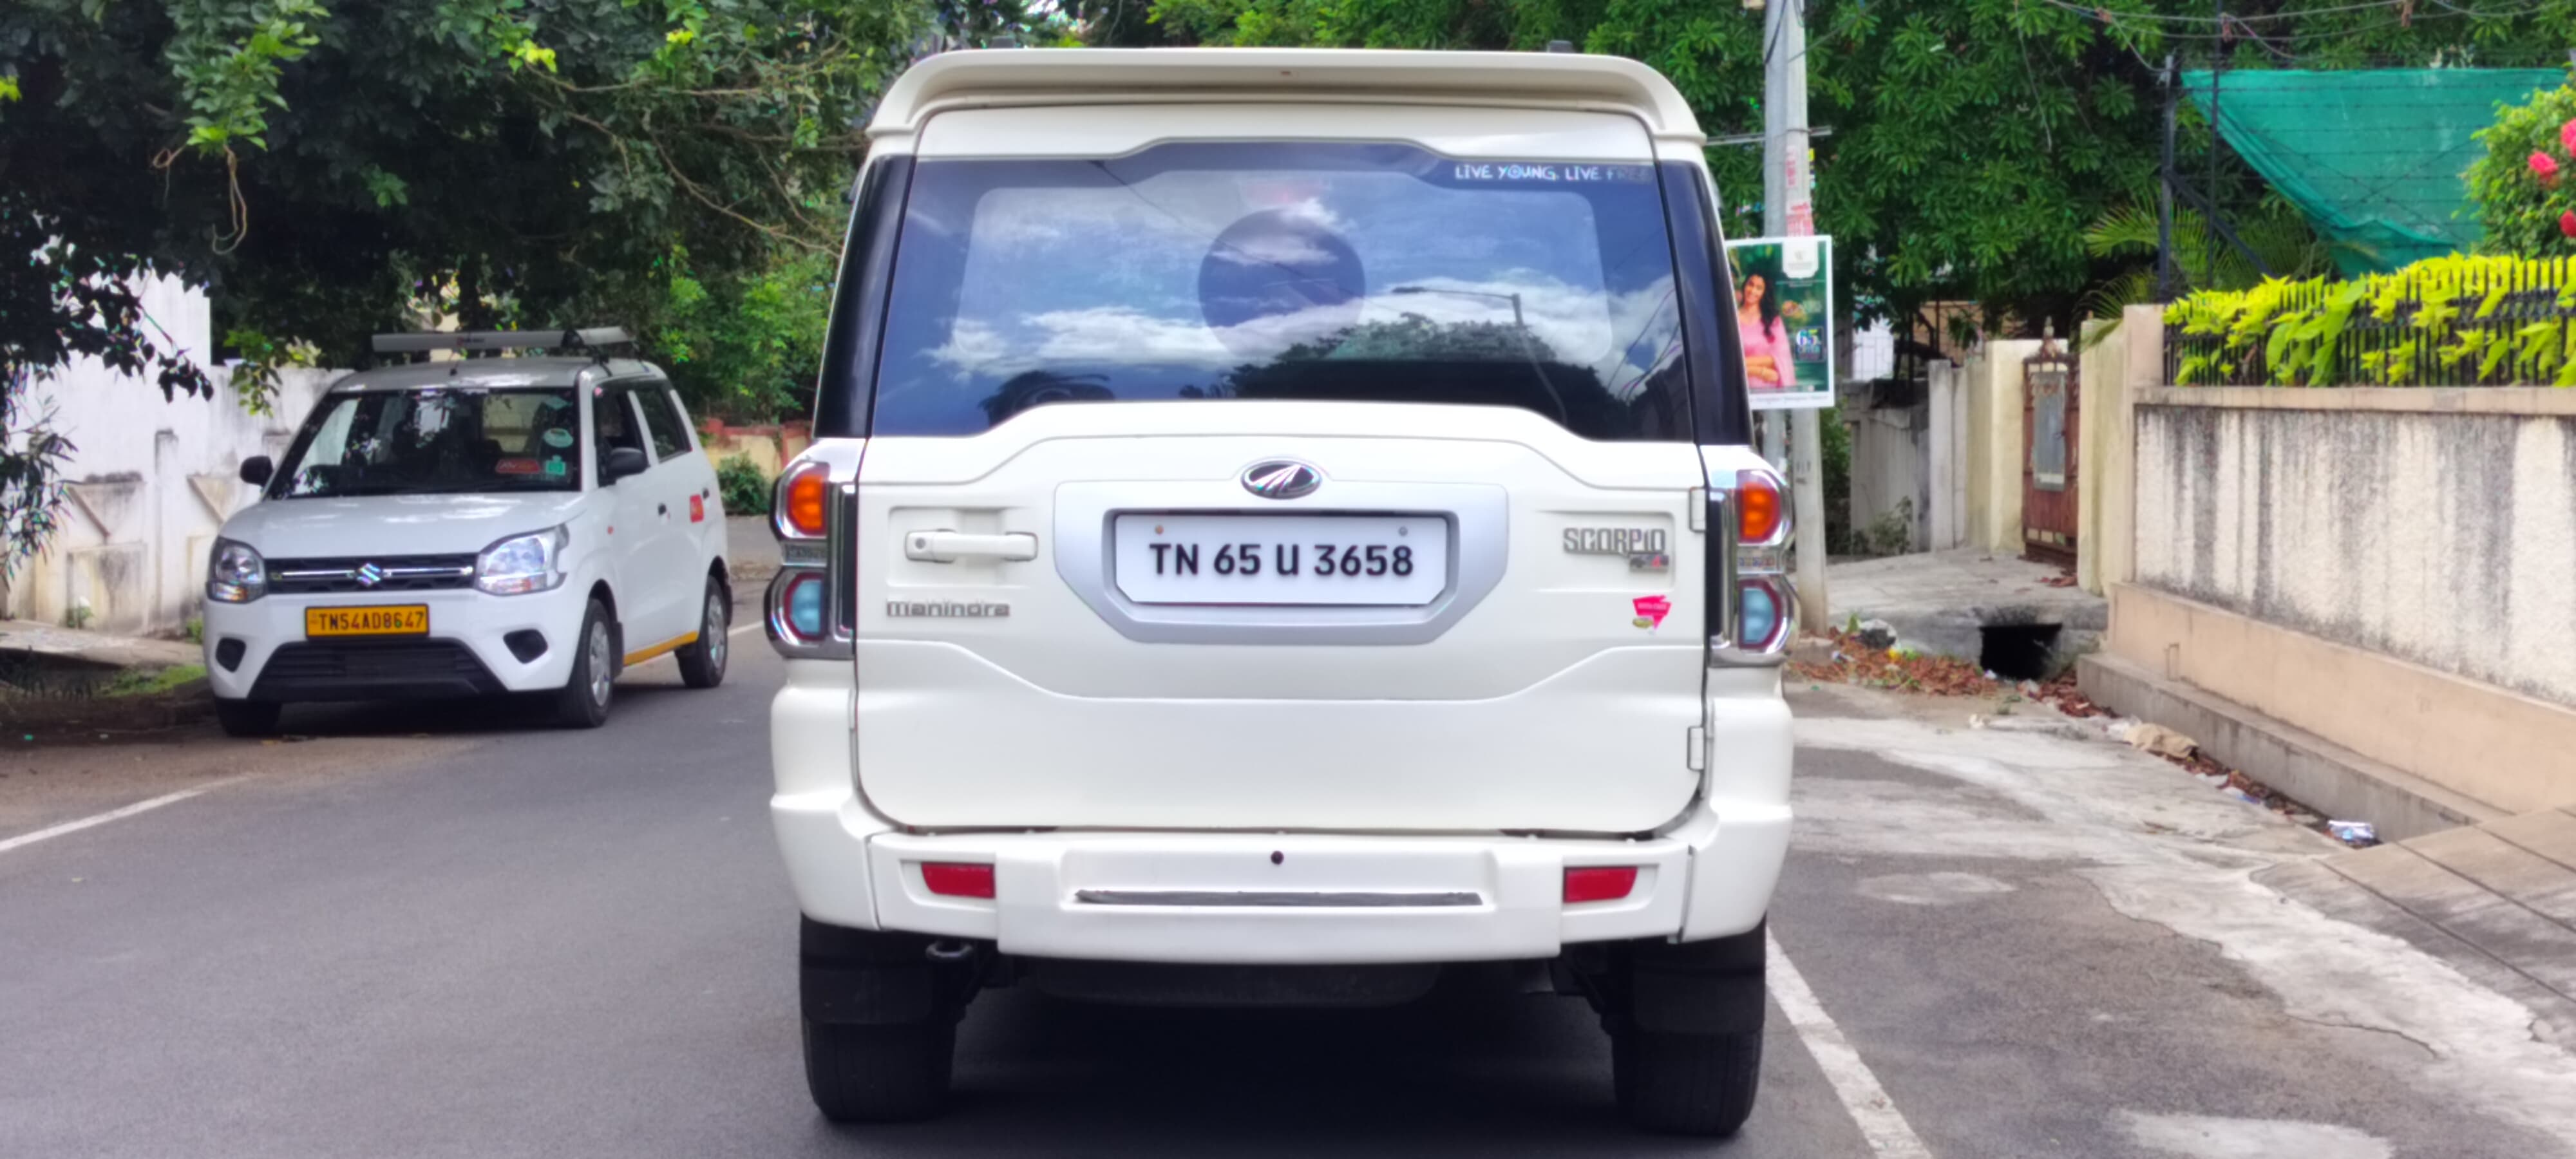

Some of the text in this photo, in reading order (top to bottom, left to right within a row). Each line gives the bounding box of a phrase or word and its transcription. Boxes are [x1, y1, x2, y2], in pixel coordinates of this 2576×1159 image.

[1455, 164, 1492, 180] LIVE
[1563, 527, 1666, 555] SCORPIO
[1149, 543, 1414, 576] TN 65 U 3658
[319, 612, 425, 631] TN54AD8647
